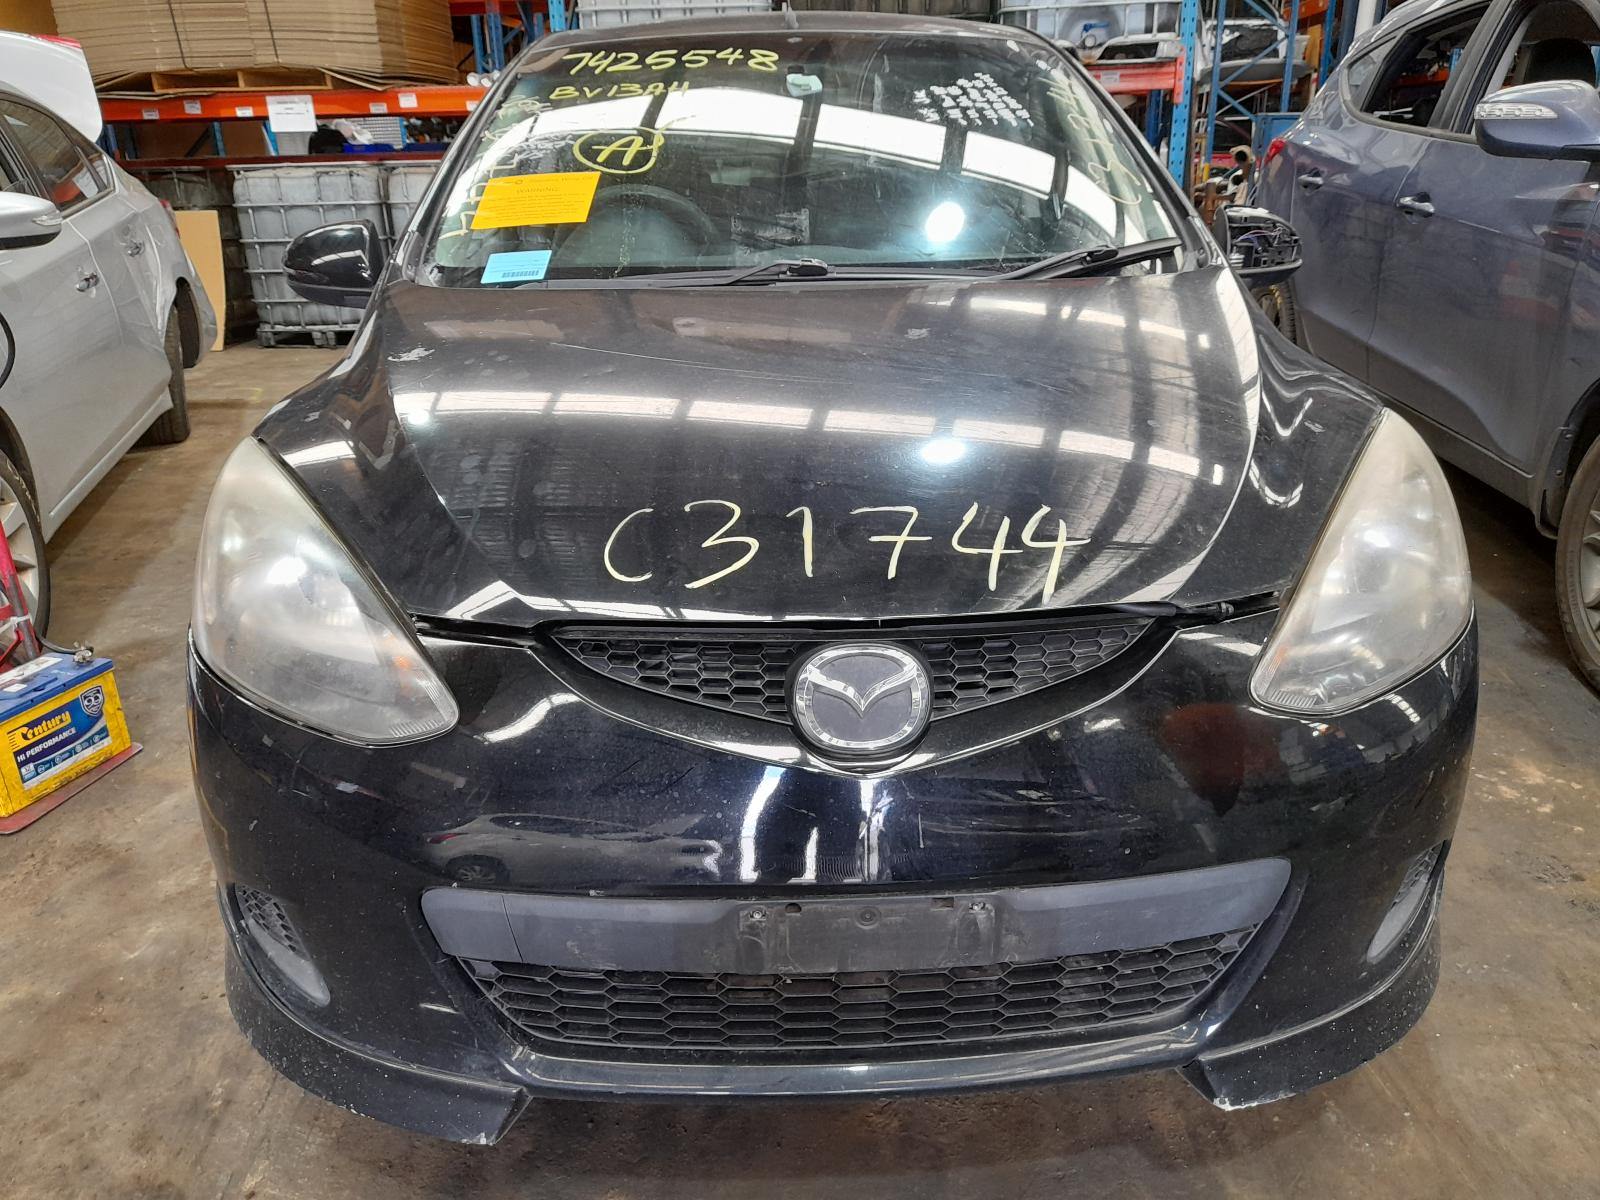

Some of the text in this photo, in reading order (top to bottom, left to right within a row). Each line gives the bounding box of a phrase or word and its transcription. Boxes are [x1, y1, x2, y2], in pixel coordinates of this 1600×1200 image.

[561, 47, 779, 76] 7425548
[592, 135, 652, 166] A
[603, 499, 1091, 605] C31744
[14, 710, 71, 744] Century
[17, 752, 26, 764] HI
[26, 727, 76, 760] PERFORMANCE
